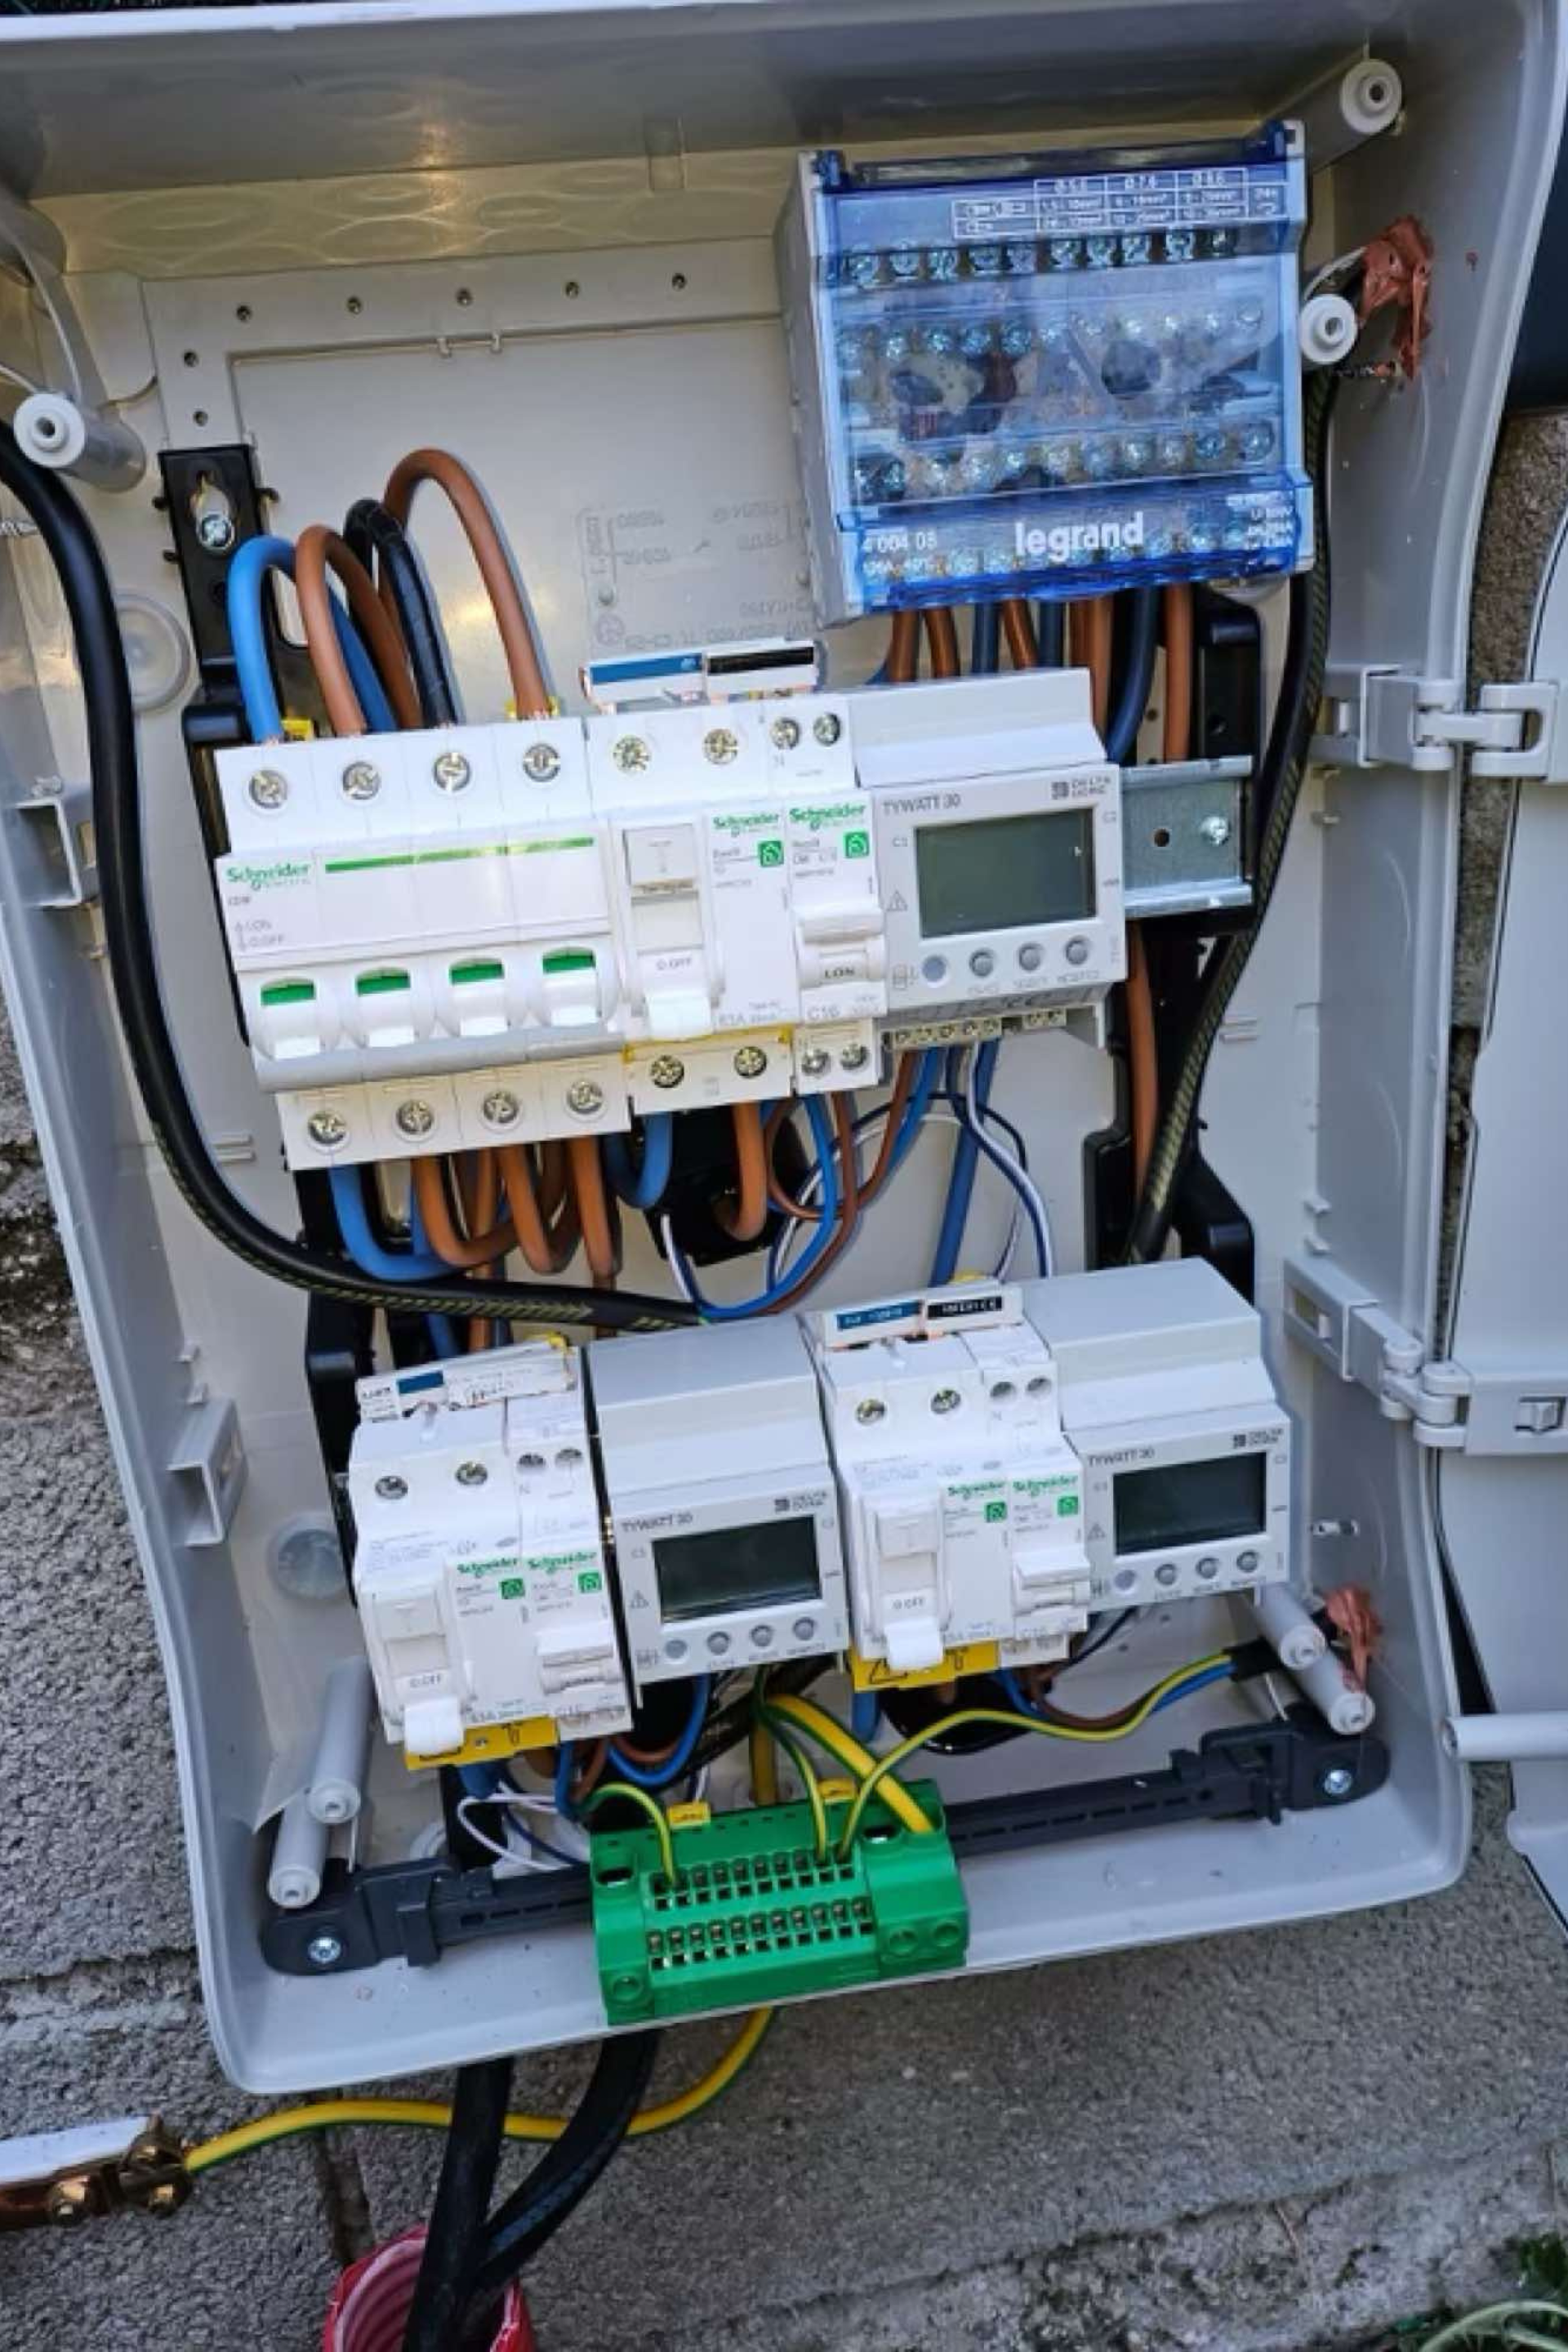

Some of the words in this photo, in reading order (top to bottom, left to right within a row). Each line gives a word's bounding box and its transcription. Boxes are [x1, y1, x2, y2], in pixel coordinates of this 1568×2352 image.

[1014, 511, 1143, 562] legrand
[884, 795, 939, 815] TYWATT
[942, 793, 961, 809] 30
[713, 813, 779, 838] Schneider
[790, 804, 866, 831] Schneider
[226, 862, 311, 891] Schneider
[1087, 1450, 1138, 1468] TYWATT
[947, 1481, 1005, 1501] Schneider
[1013, 1475, 1079, 1499] Schneider
[457, 1557, 518, 1579] Schneider
[528, 1552, 597, 1575] Schneider
